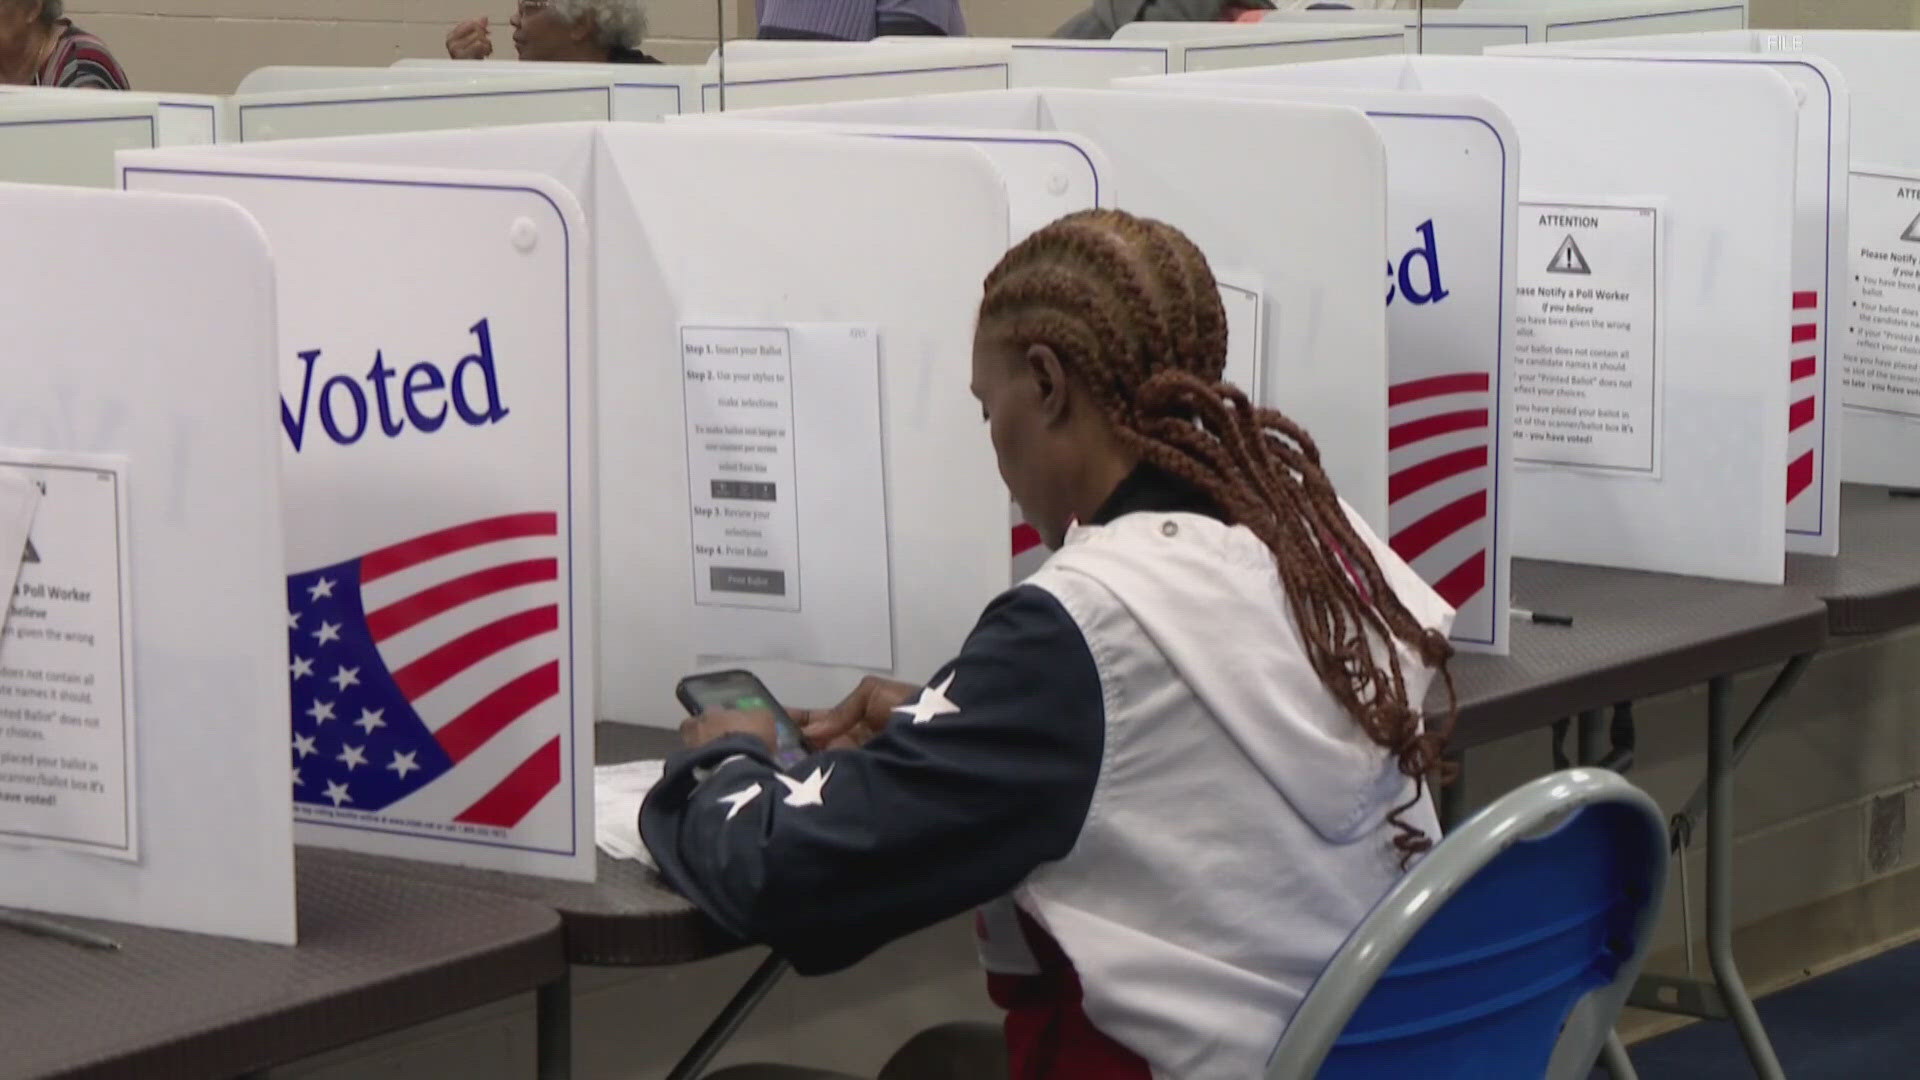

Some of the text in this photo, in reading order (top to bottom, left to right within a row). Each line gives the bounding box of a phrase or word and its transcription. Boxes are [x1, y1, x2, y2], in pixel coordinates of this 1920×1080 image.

[1538, 214, 1599, 228] ATTENTION
[1860, 248, 1917, 266] Please Notify
[1863, 275, 1877, 284] You
[1878, 276, 1896, 287] have
[1538, 286, 1566, 300] Notify
[1568, 289, 1575, 299] a
[1576, 288, 1594, 300] Poll
[1595, 289, 1630, 302] Worker
[1550, 305, 1565, 313] you
[1566, 304, 1594, 314] believe
[1861, 302, 1877, 311] Your
[1879, 304, 1899, 314] ballot
[1528, 316, 1547, 326] have
[1548, 317, 1567, 327] been
[1569, 319, 1590, 329] given
[1591, 319, 1605, 329] the
[1606, 320, 1631, 332] wrong
[1859, 313, 1871, 322] the
[1872, 315, 1908, 327] candidate
[1864, 329, 1881, 338] your
[685, 344, 704, 356] Step
[715, 344, 738, 355] Insert
[740, 346, 757, 358] your
[760, 344, 782, 356] Ballot
[1531, 344, 1553, 354] ballot
[1554, 346, 1573, 356] does
[1575, 347, 1588, 357] not
[1589, 349, 1619, 359] contain
[1620, 350, 1630, 359] all
[1882, 343, 1898, 352] your
[1526, 357, 1564, 368] candidate
[1565, 360, 1591, 370] names
[1874, 356, 1892, 368] have
[687, 370, 706, 382] Step
[717, 370, 731, 380] Use
[733, 373, 750, 383] your
[752, 371, 774, 383] stylus
[775, 372, 785, 381] to
[1518, 373, 1535, 383] your
[1598, 377, 1618, 388] does
[1619, 379, 1633, 389] not
[1538, 388, 1555, 397] your
[1872, 383, 1886, 393] you
[1887, 383, 1905, 395] have
[741, 396, 778, 408] selections
[1531, 402, 1549, 413] have
[1551, 405, 1577, 416] placed
[1578, 408, 1596, 418] your
[1597, 407, 1620, 418] ballot
[1534, 416, 1547, 427] the
[1605, 422, 1619, 433] box
[1530, 433, 1545, 442] you
[1546, 431, 1565, 442] have
[1566, 433, 1593, 444] voted!
[694, 506, 713, 519] Step
[724, 506, 751, 518] Review
[752, 510, 770, 521] your
[695, 544, 714, 557] Step
[725, 545, 744, 556] Print
[746, 546, 768, 558] Ballot
[22, 582, 45, 599] Poll
[47, 585, 91, 602] Worker
[17, 628, 43, 640] given
[45, 628, 61, 641] the
[65, 631, 95, 647] wrong
[26, 669, 43, 681] not
[45, 671, 81, 683] contain
[15, 686, 48, 700] names
[60, 712, 81, 727] does
[84, 716, 100, 729] not
[0, 752, 34, 766] placed
[36, 756, 58, 769] your
[60, 756, 87, 771] ballot
